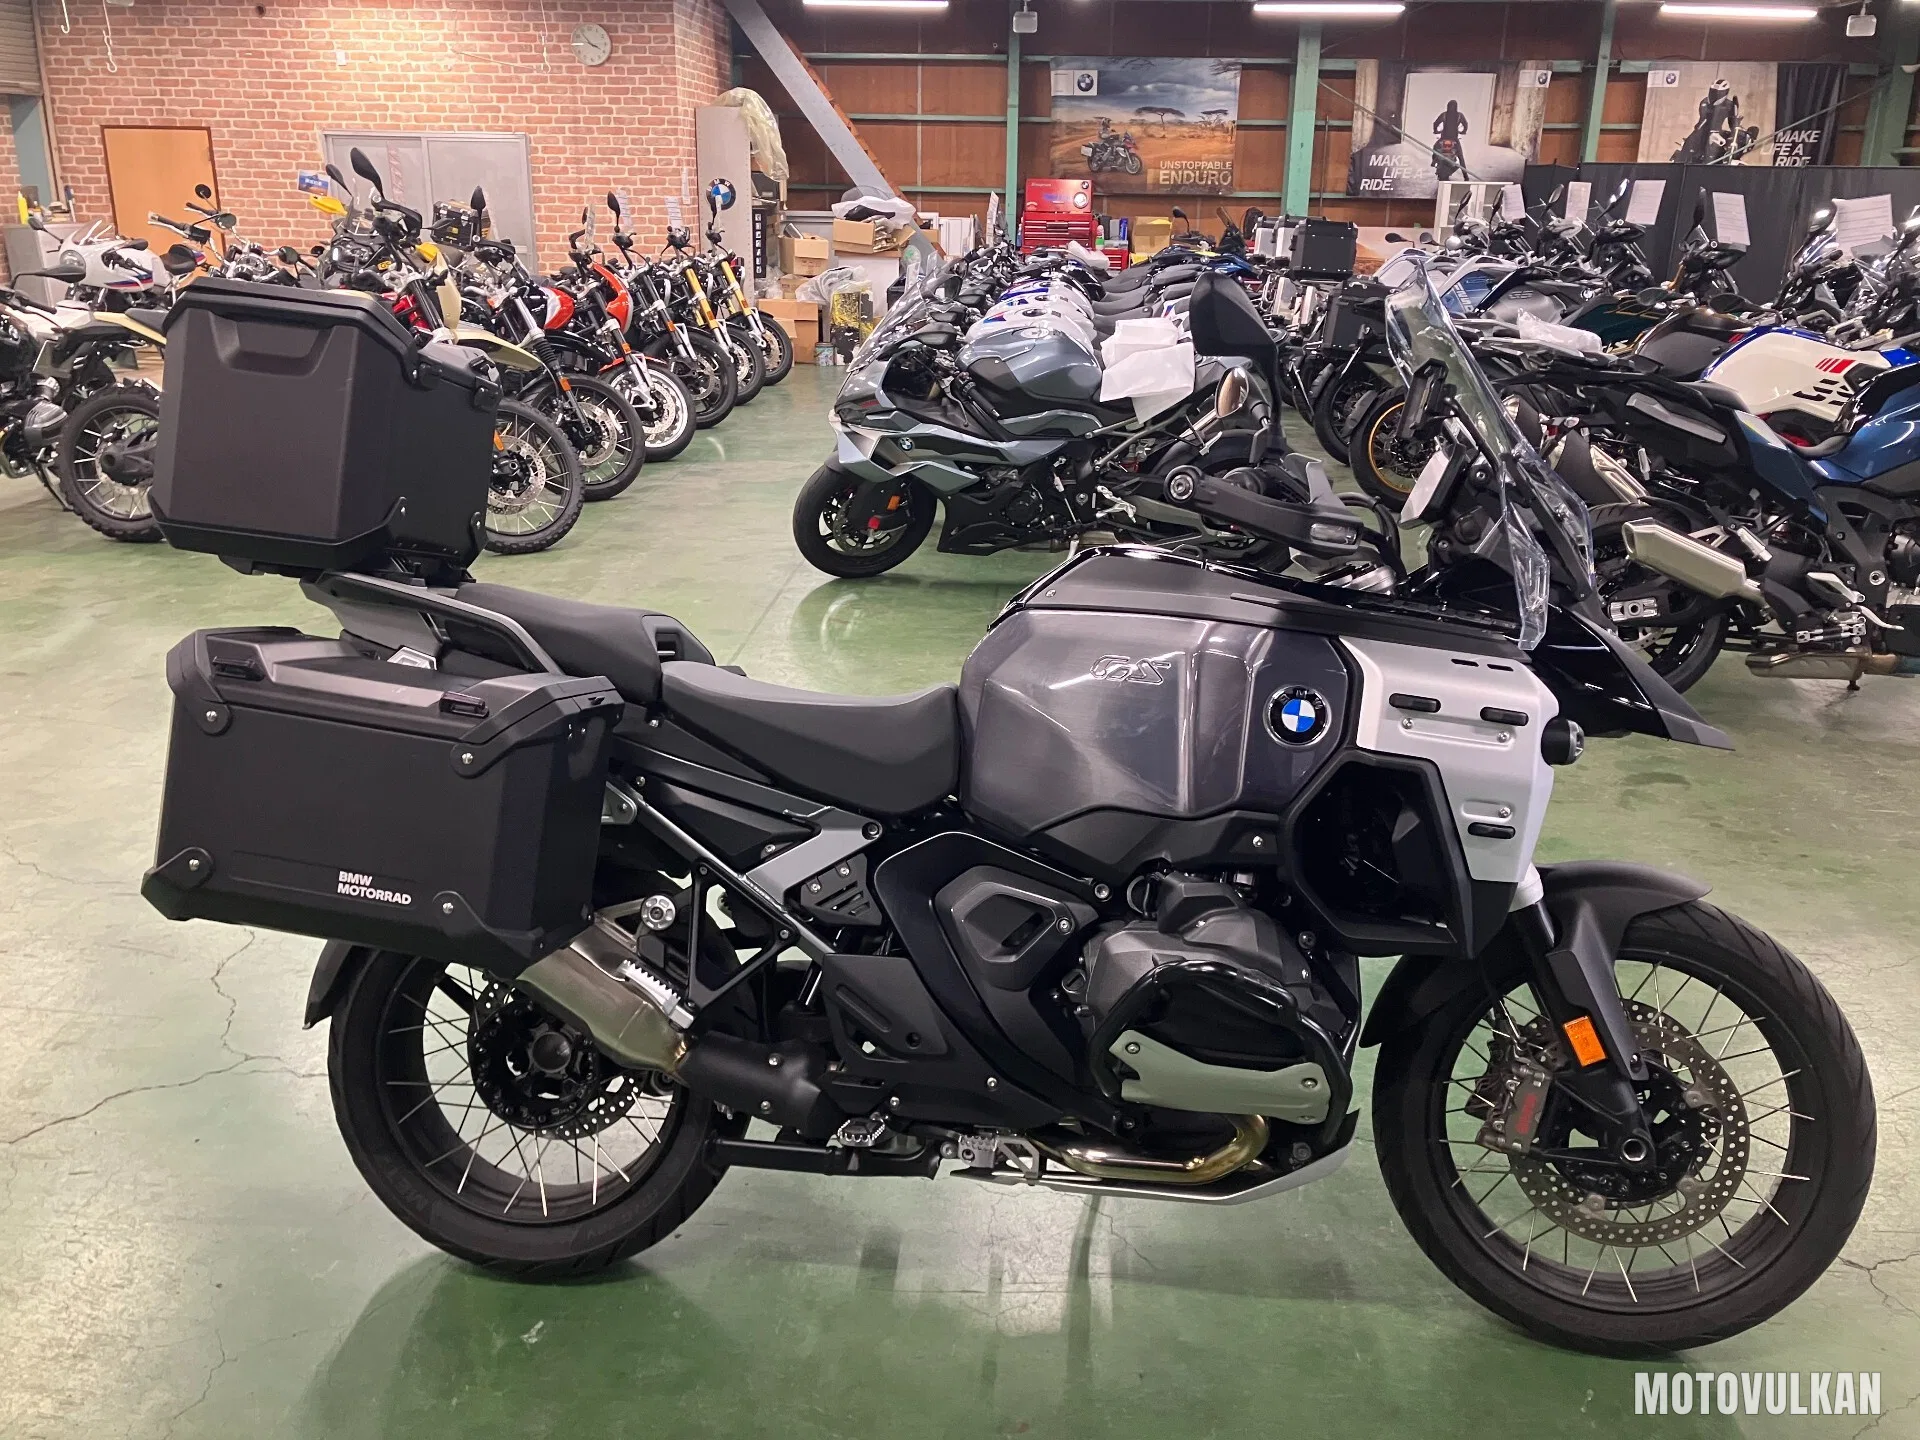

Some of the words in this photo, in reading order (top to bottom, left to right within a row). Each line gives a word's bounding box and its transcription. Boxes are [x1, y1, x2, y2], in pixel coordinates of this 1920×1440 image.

[1775, 130, 1821, 143] MAKE
[1792, 143, 1804, 156] A
[1160, 160, 1233, 170] UNSTOPPABLE
[1369, 154, 1409, 167] MAKE
[1159, 170, 1232, 185] ENDURO
[1382, 167, 1412, 179] LIFE
[1413, 168, 1424, 179] A
[1360, 179, 1394, 191] RIDE.
[1089, 654, 1172, 685] GS
[1279, 689, 1324, 711] BMW
[338, 870, 373, 887] BMW
[337, 882, 412, 905] MOTORRAD
